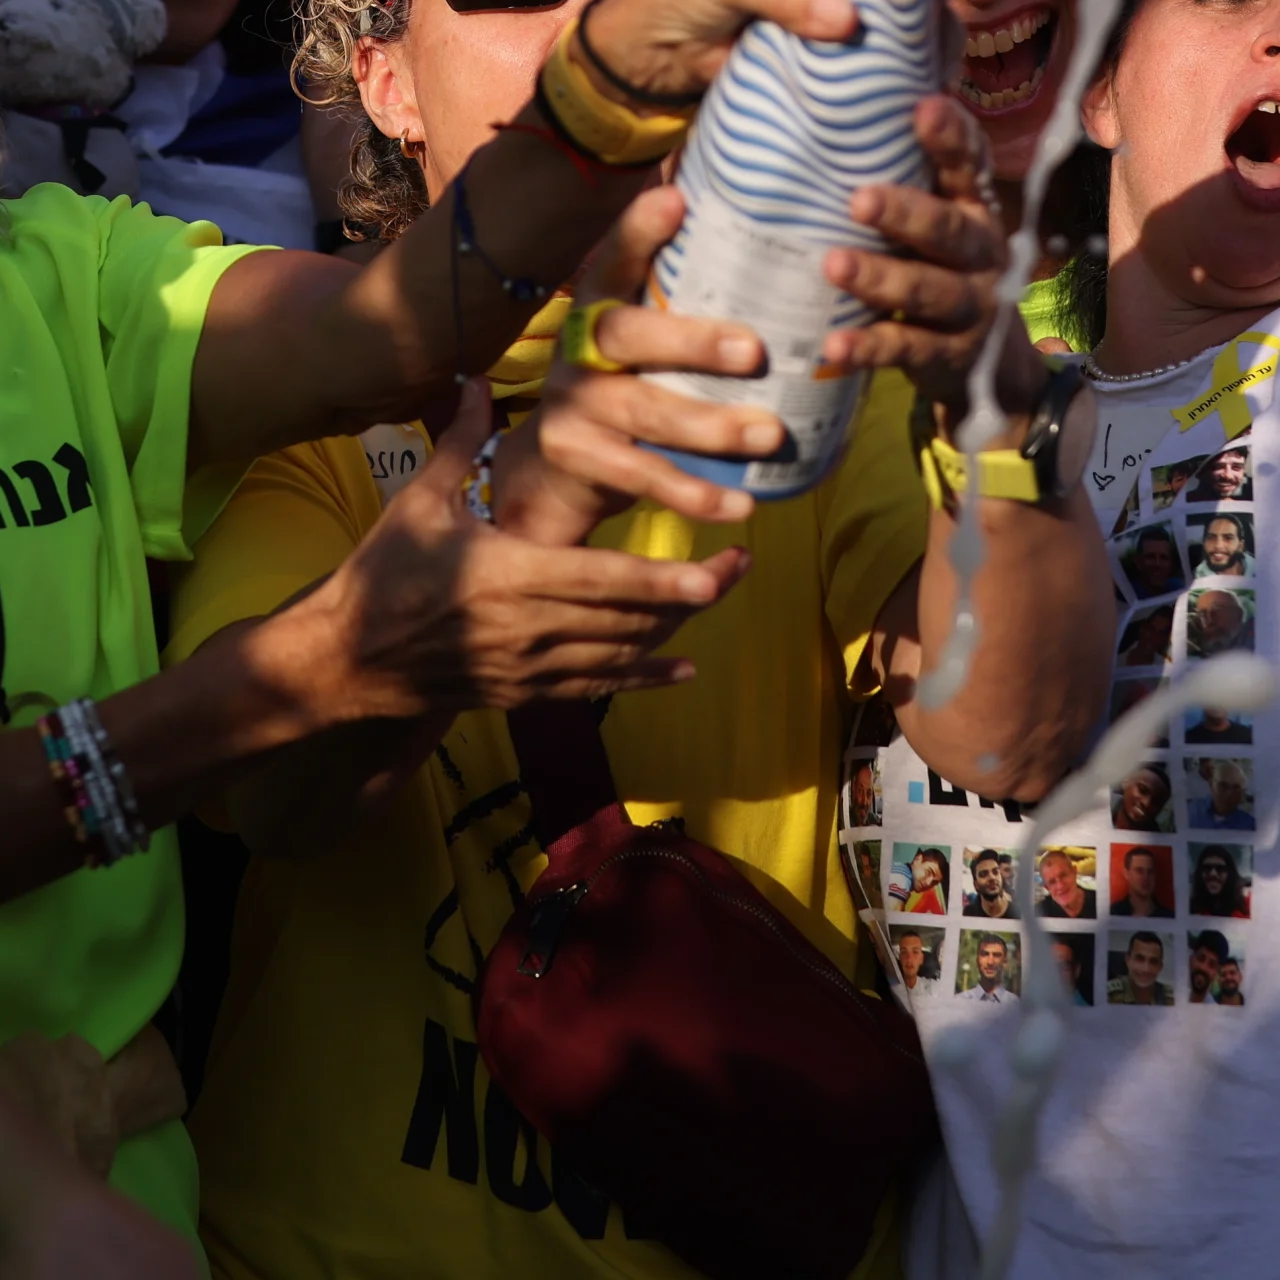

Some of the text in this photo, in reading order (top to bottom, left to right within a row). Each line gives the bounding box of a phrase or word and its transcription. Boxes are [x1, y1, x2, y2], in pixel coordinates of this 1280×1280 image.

[1187, 365, 1272, 420] עד החטוף האחרון
